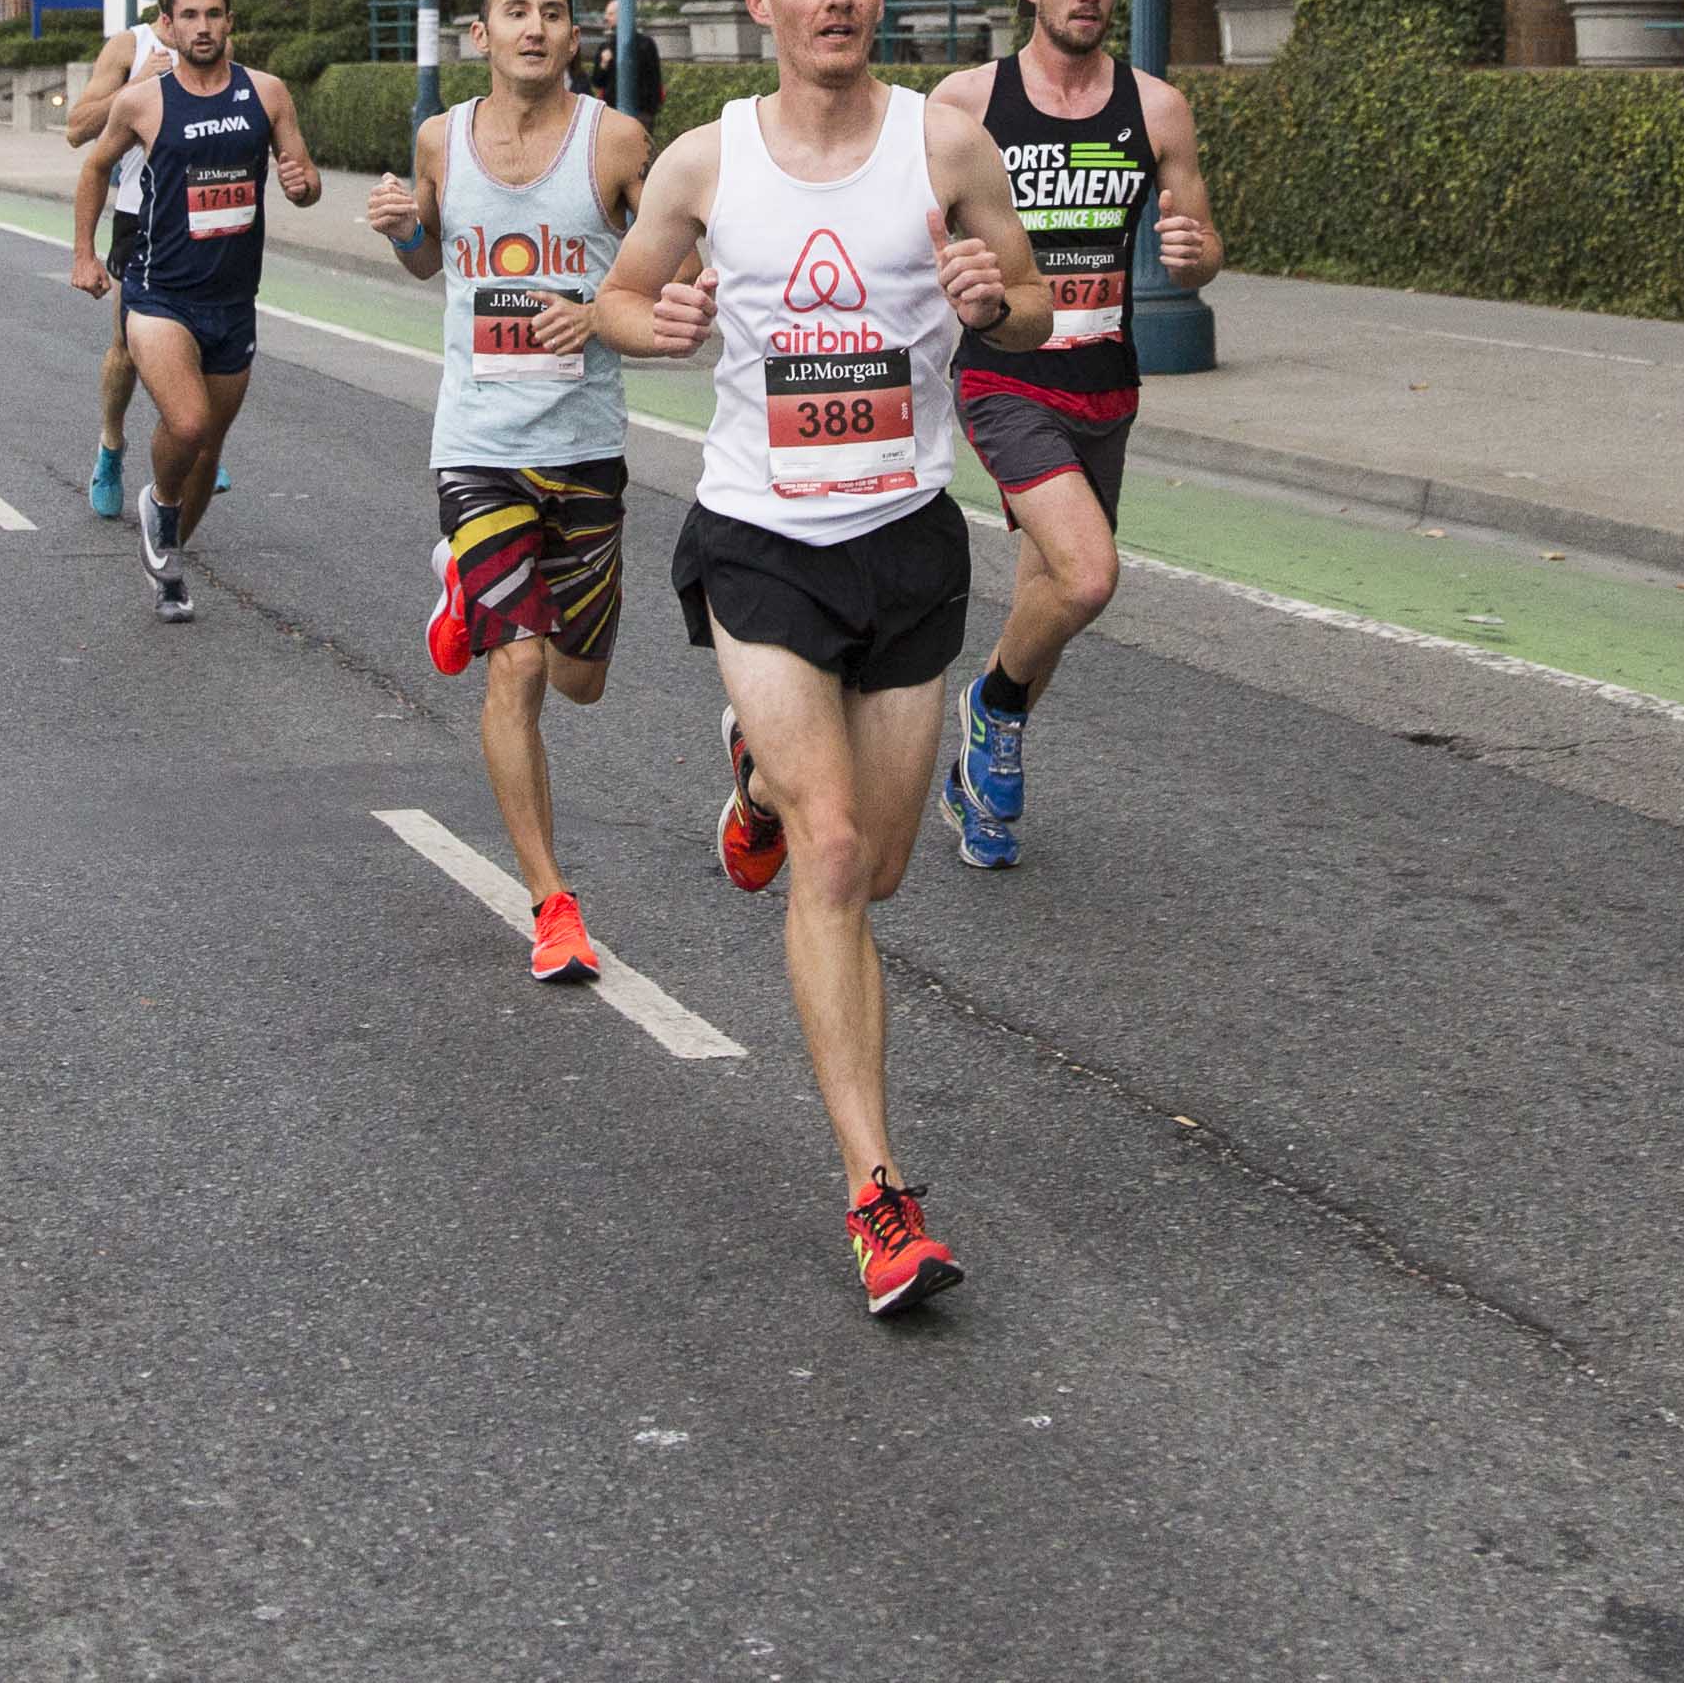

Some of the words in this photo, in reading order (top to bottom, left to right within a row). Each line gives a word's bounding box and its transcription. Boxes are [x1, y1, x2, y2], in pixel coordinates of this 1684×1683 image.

[183, 115, 251, 140] STRAVA
[197, 187, 246, 208] 1719
[1050, 211, 1089, 229] SINCE
[1092, 210, 1122, 228] 1998
[455, 223, 587, 279] aloha
[1045, 252, 1115, 269] J.P.Morgan
[771, 321, 884, 355] airbnb
[785, 361, 889, 384] J.P.Morgan
[797, 398, 875, 439] 388
